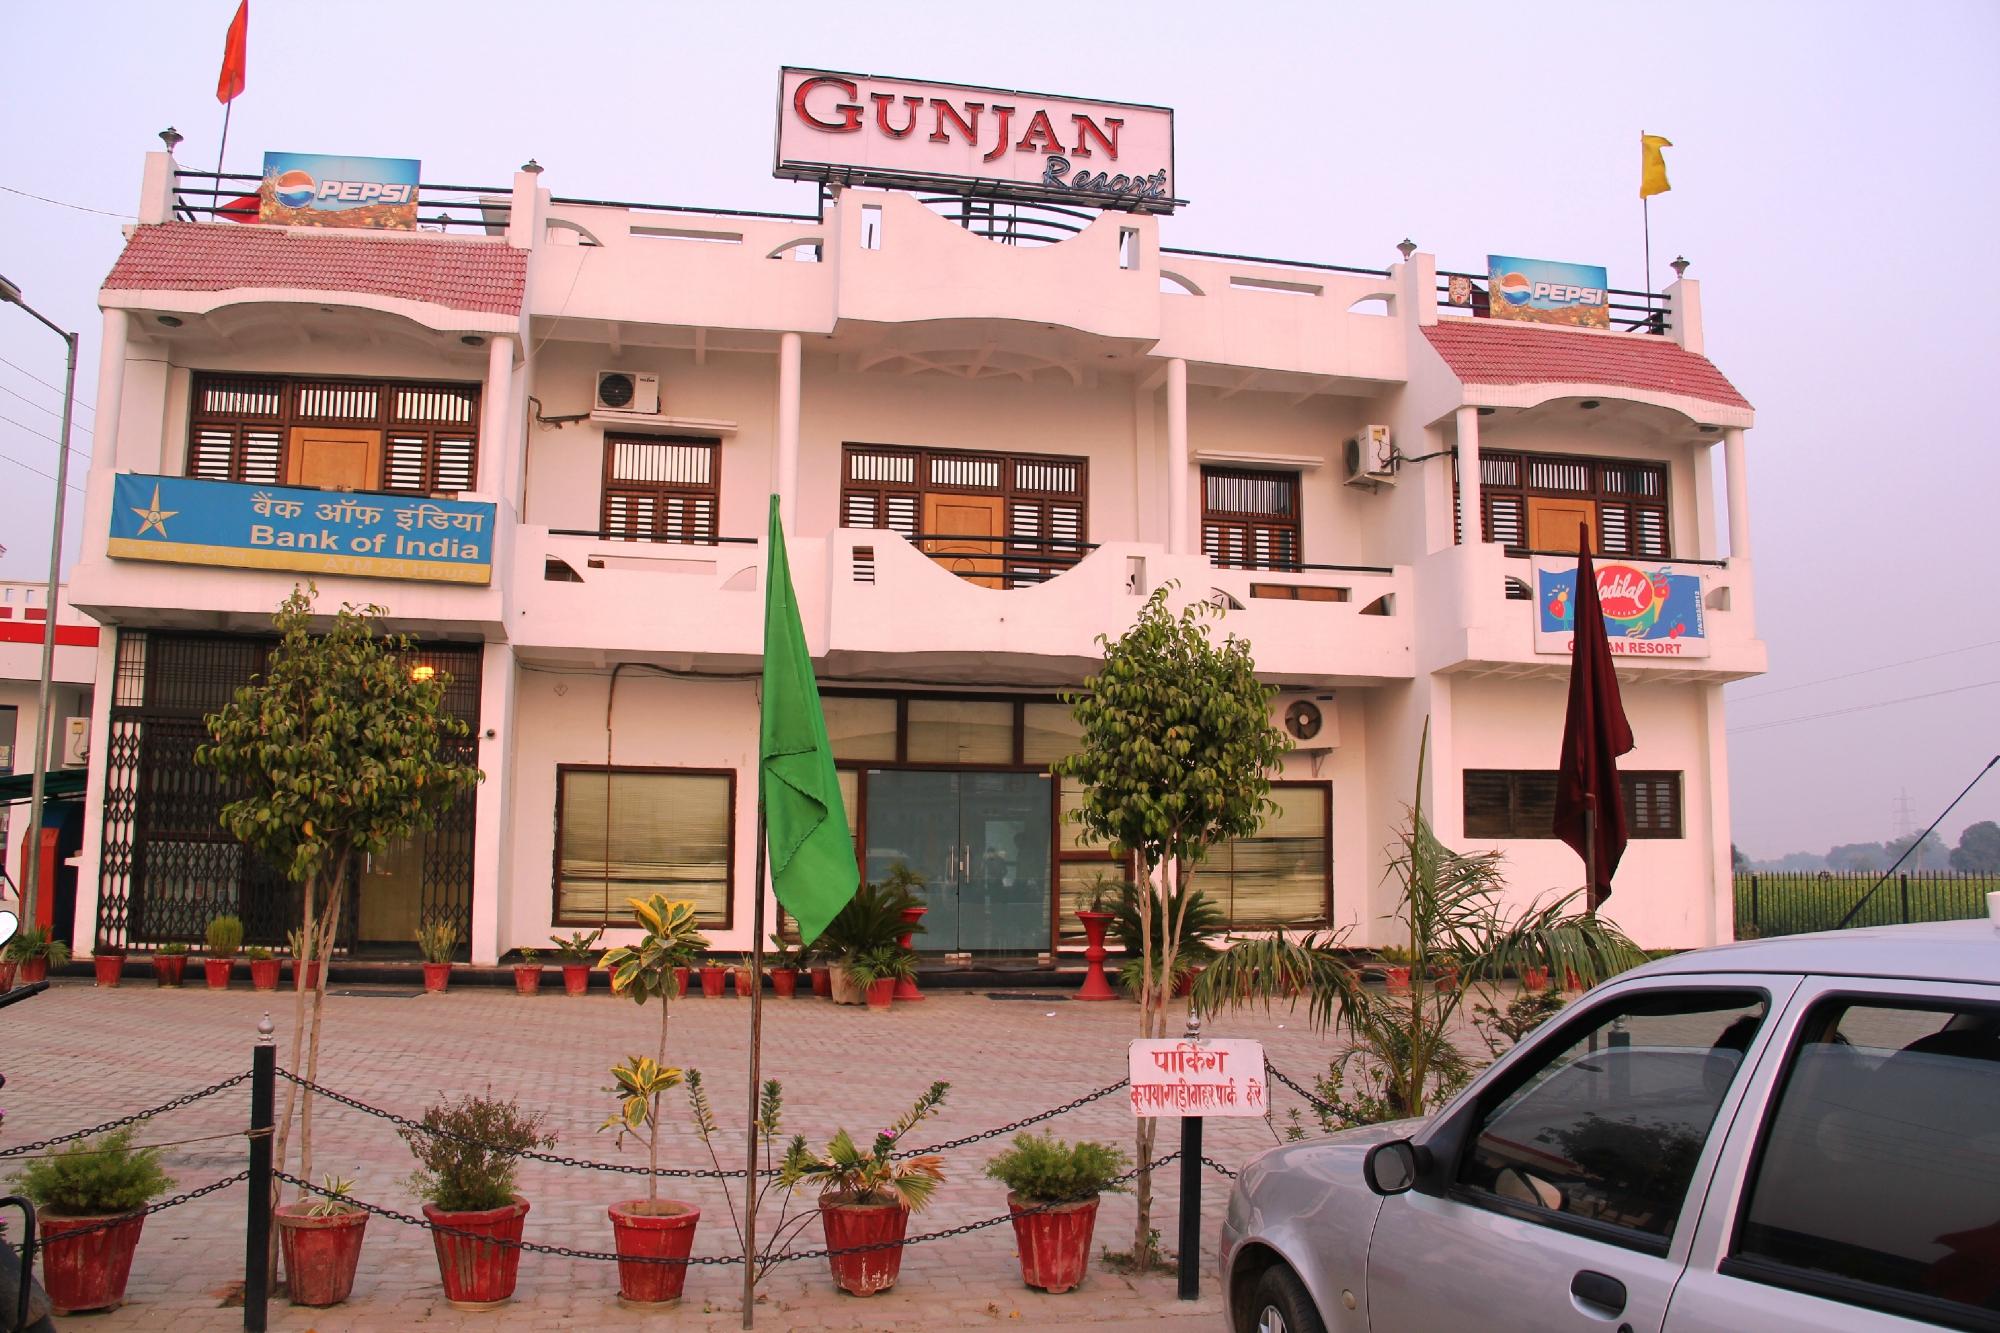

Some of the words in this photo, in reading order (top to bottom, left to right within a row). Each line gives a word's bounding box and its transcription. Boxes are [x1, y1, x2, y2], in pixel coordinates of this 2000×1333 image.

[794, 76, 1124, 161] GUNJAN
[1043, 156, 1167, 198] Resort
[317, 180, 413, 204] PEPSI
[1533, 281, 1604, 305] PEPSI
[250, 491, 304, 519] बैंक
[393, 504, 485, 533] इंडिया
[250, 525, 339, 551] Bank
[351, 534, 387, 554] of
[396, 535, 479, 559] India
[323, 556, 372, 573] ATM
[1629, 642, 1682, 655] RESORT
